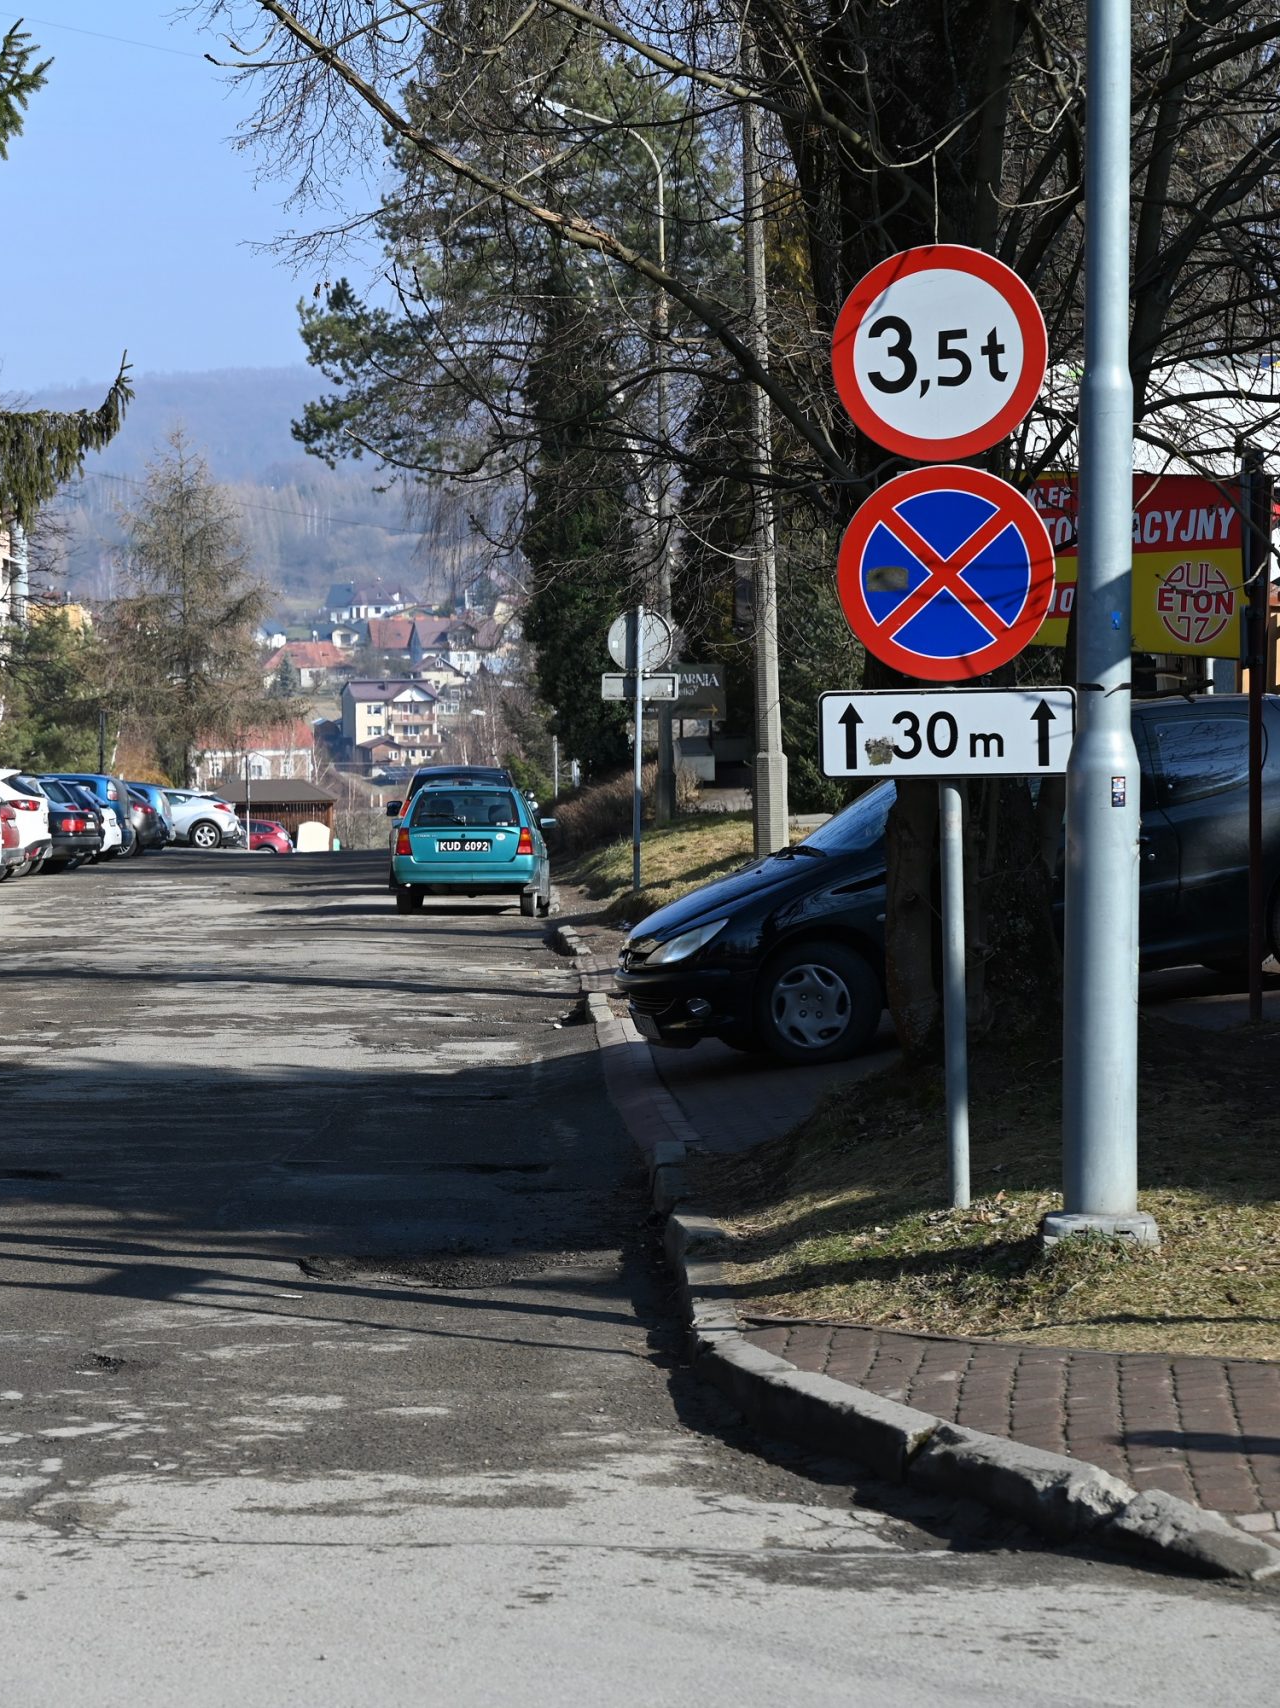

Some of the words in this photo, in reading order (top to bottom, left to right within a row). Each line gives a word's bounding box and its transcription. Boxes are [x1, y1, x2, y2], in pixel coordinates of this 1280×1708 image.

[1026, 487, 1071, 509] KLEP
[1157, 587, 1234, 616] ETON
[891, 710, 959, 760] 30
[969, 732, 1004, 758] m
[440, 841, 461, 851] KUD
[464, 841, 488, 851] 6092
